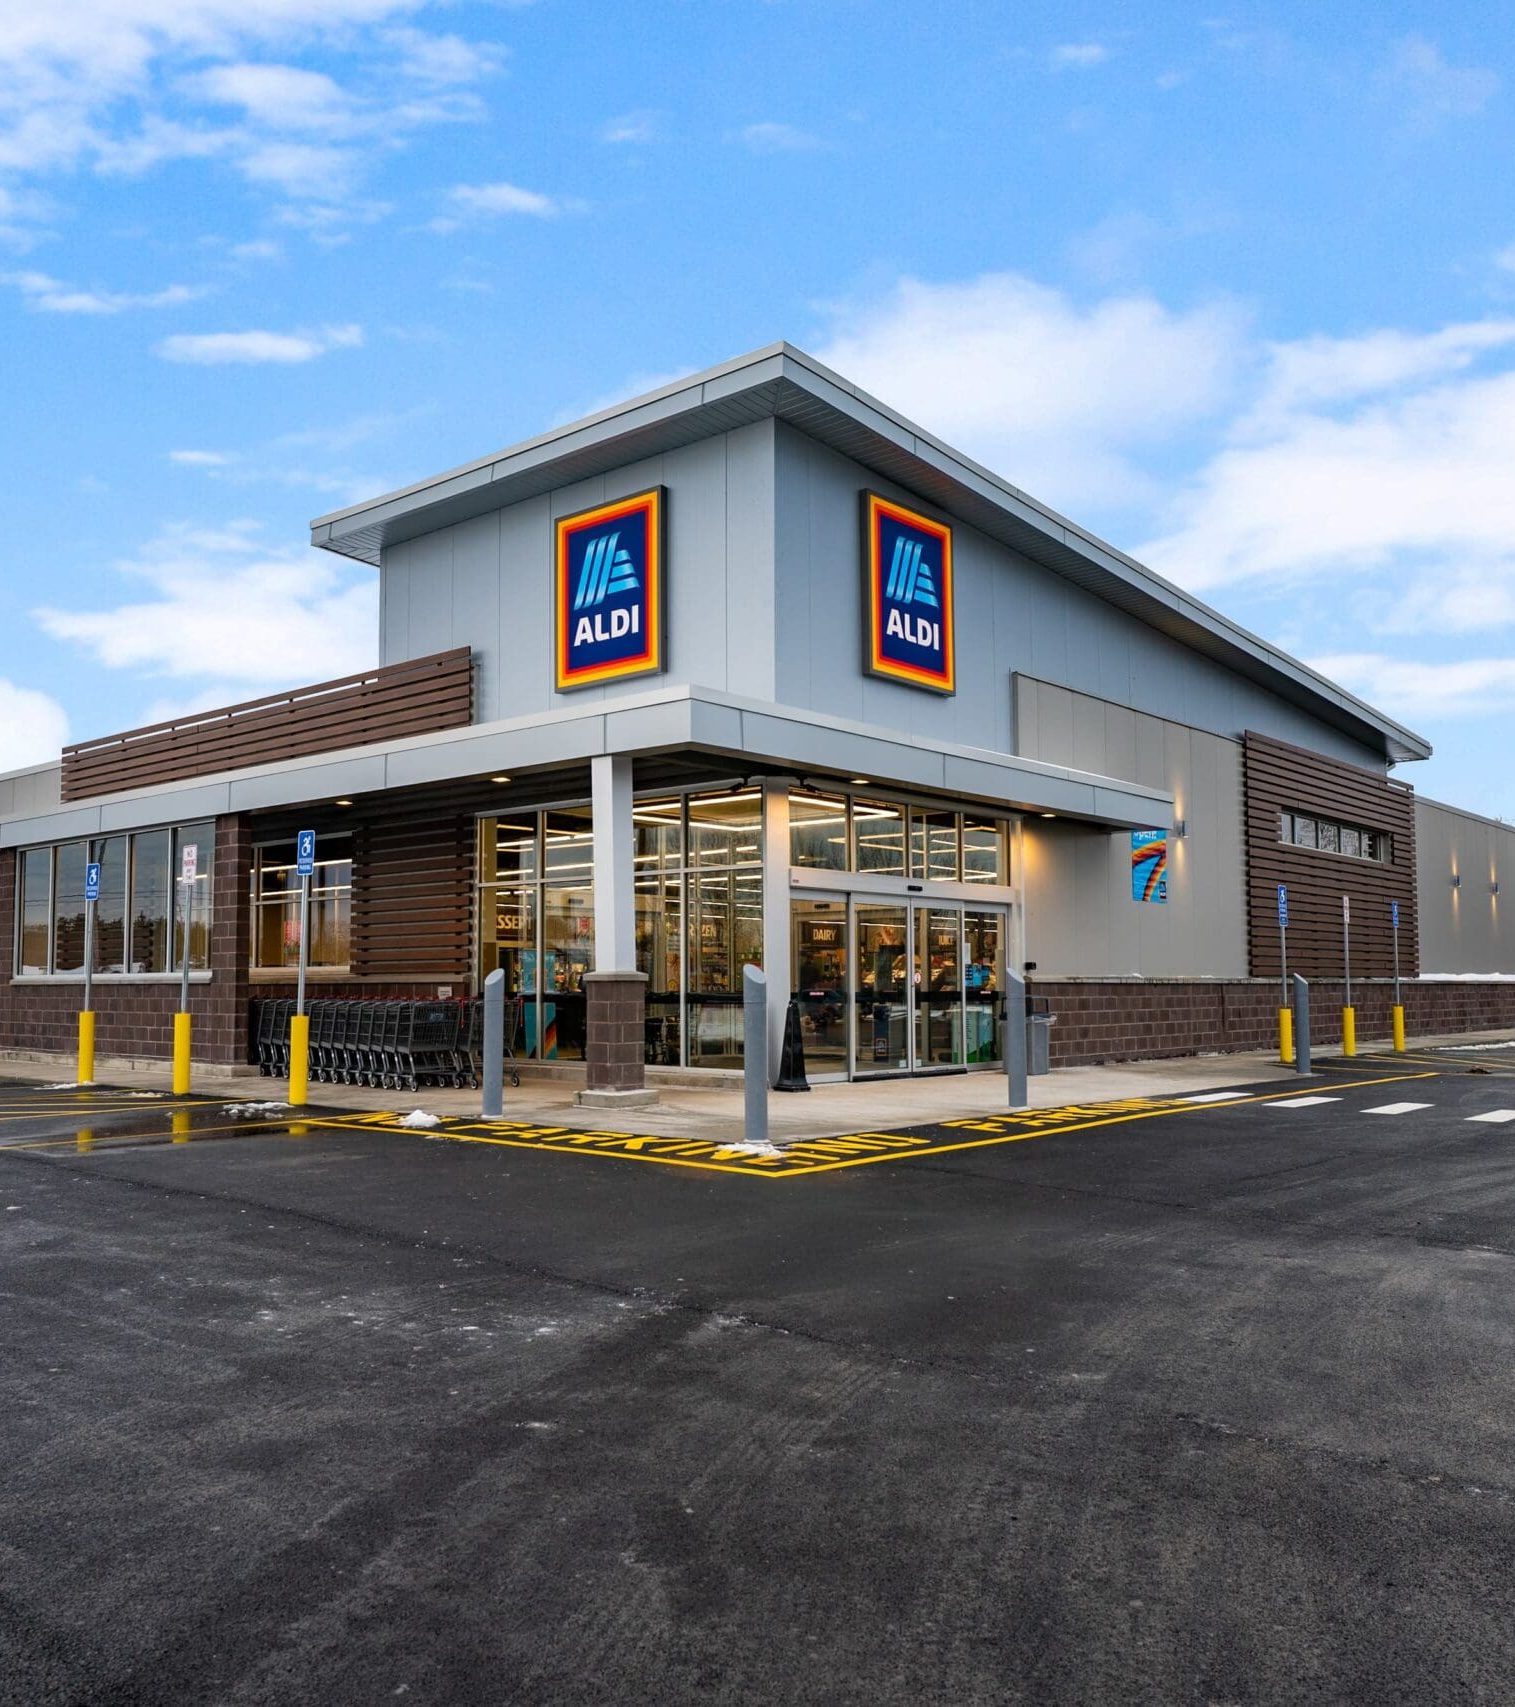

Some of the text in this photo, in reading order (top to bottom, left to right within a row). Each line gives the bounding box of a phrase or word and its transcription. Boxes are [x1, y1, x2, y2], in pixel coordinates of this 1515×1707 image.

[574, 604, 639, 647] ALDI
[886, 608, 939, 651] ALDI
[496, 915, 532, 930] SSERT
[813, 928, 837, 941] DAIRY
[788, 1097, 1193, 1154] NO PARKING
